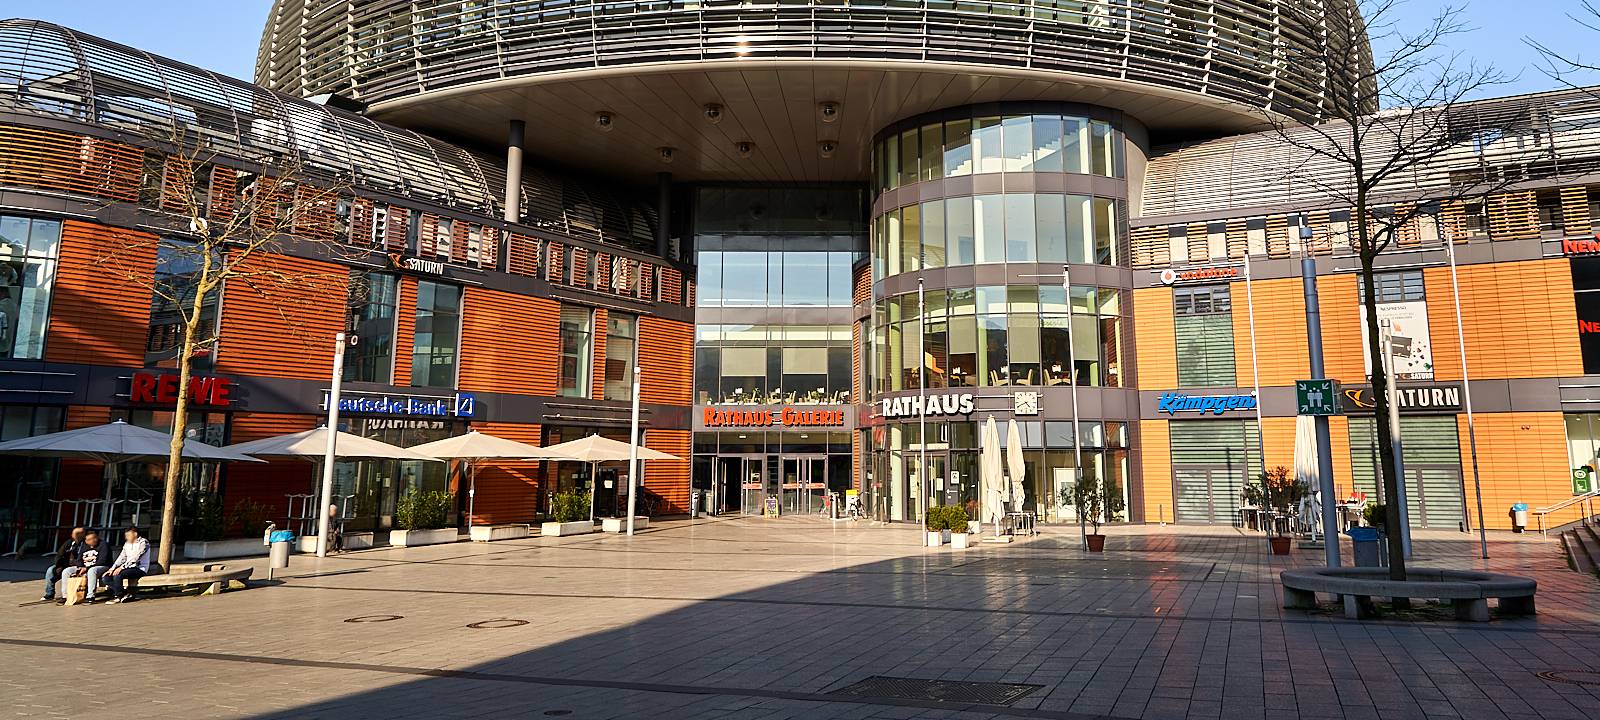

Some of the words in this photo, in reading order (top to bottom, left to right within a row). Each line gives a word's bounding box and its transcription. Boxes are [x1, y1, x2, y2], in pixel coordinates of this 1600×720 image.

[409, 258, 444, 275] SATURN
[1179, 267, 1237, 280] vodafone
[131, 372, 230, 406] REWE
[407, 397, 447, 417] Bank
[882, 393, 975, 418] RATHAUS
[1158, 391, 1256, 416] Kämpgen
[703, 407, 844, 427] RATHAUS-GALERIE
